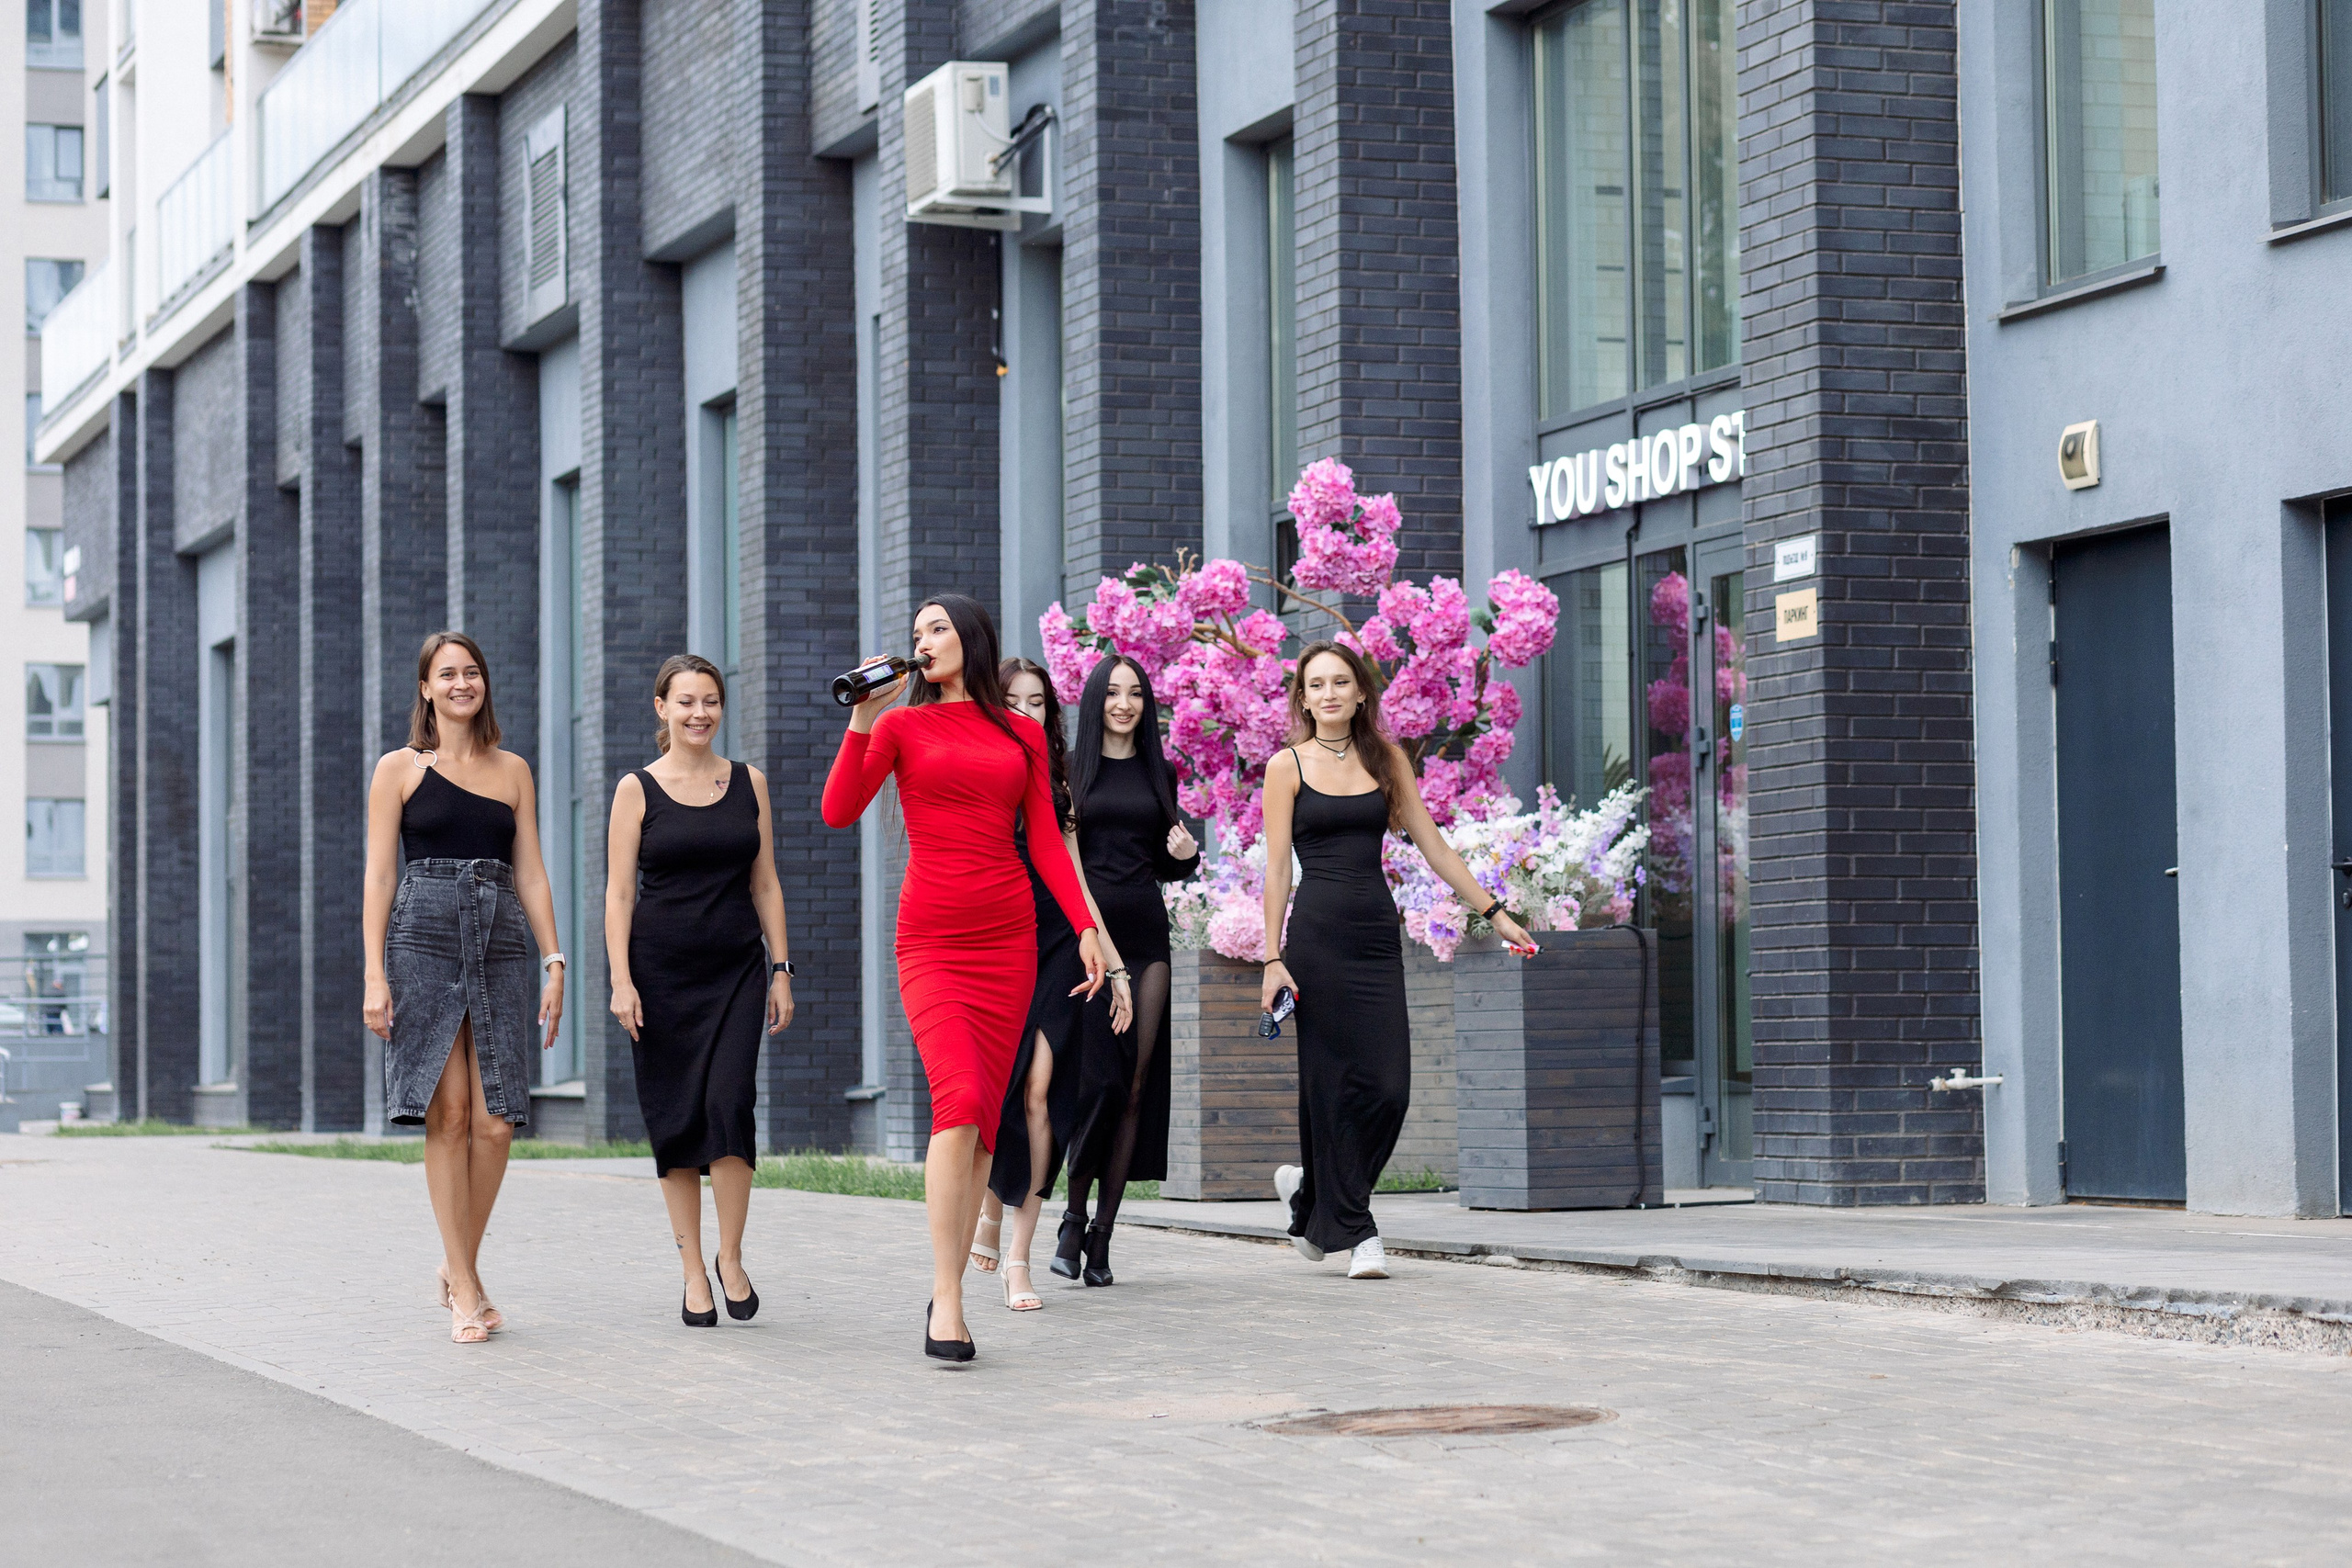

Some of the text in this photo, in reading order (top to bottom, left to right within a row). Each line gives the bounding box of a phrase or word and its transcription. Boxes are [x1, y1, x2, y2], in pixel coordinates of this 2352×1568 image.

[1529, 449, 1600, 525] YOU
[1605, 423, 1702, 509] SHOP
[1783, 605, 1809, 625] ПАРКИНГ
